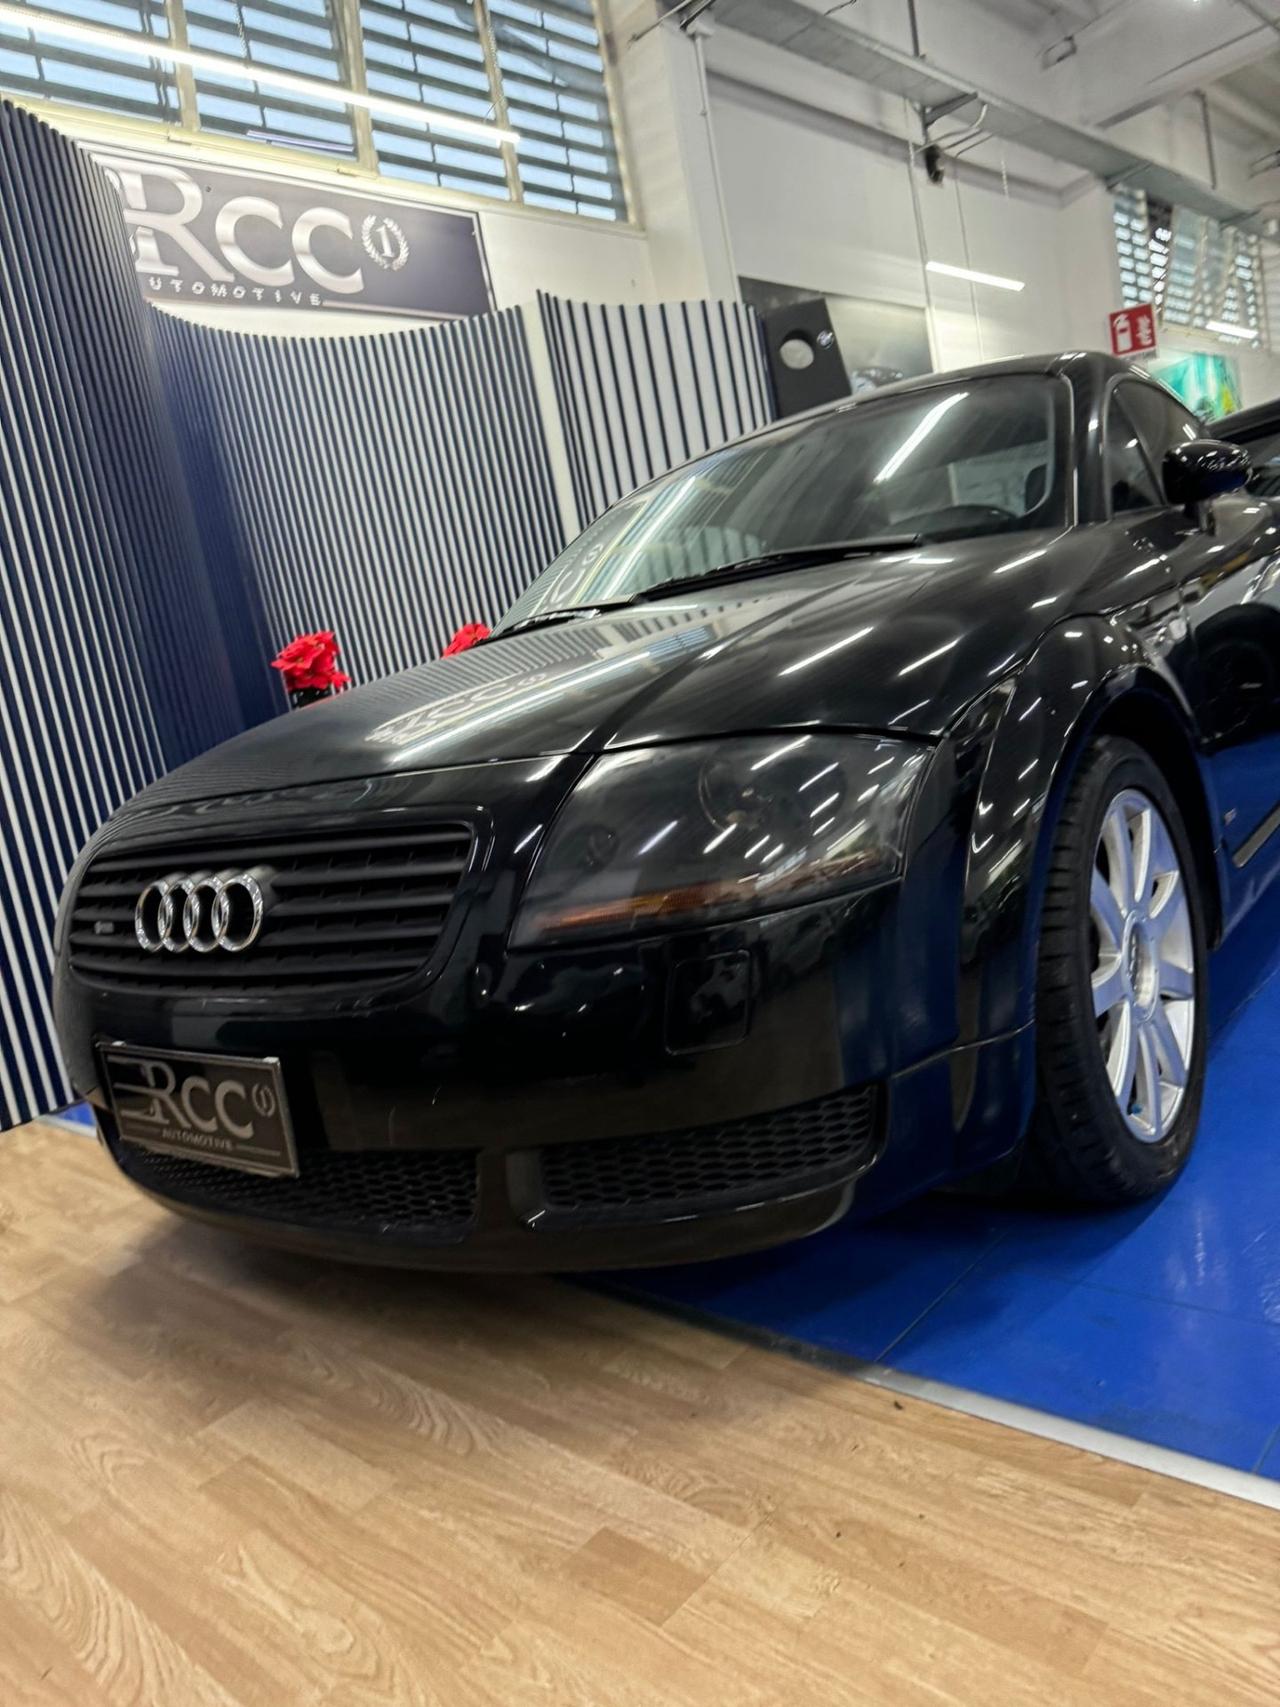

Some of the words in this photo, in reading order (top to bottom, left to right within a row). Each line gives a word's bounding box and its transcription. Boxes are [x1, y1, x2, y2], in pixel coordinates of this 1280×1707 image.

[102, 158, 364, 294] RCC
[147, 275, 323, 307] UTOMOTIVE
[140, 1060, 254, 1140] RCC
